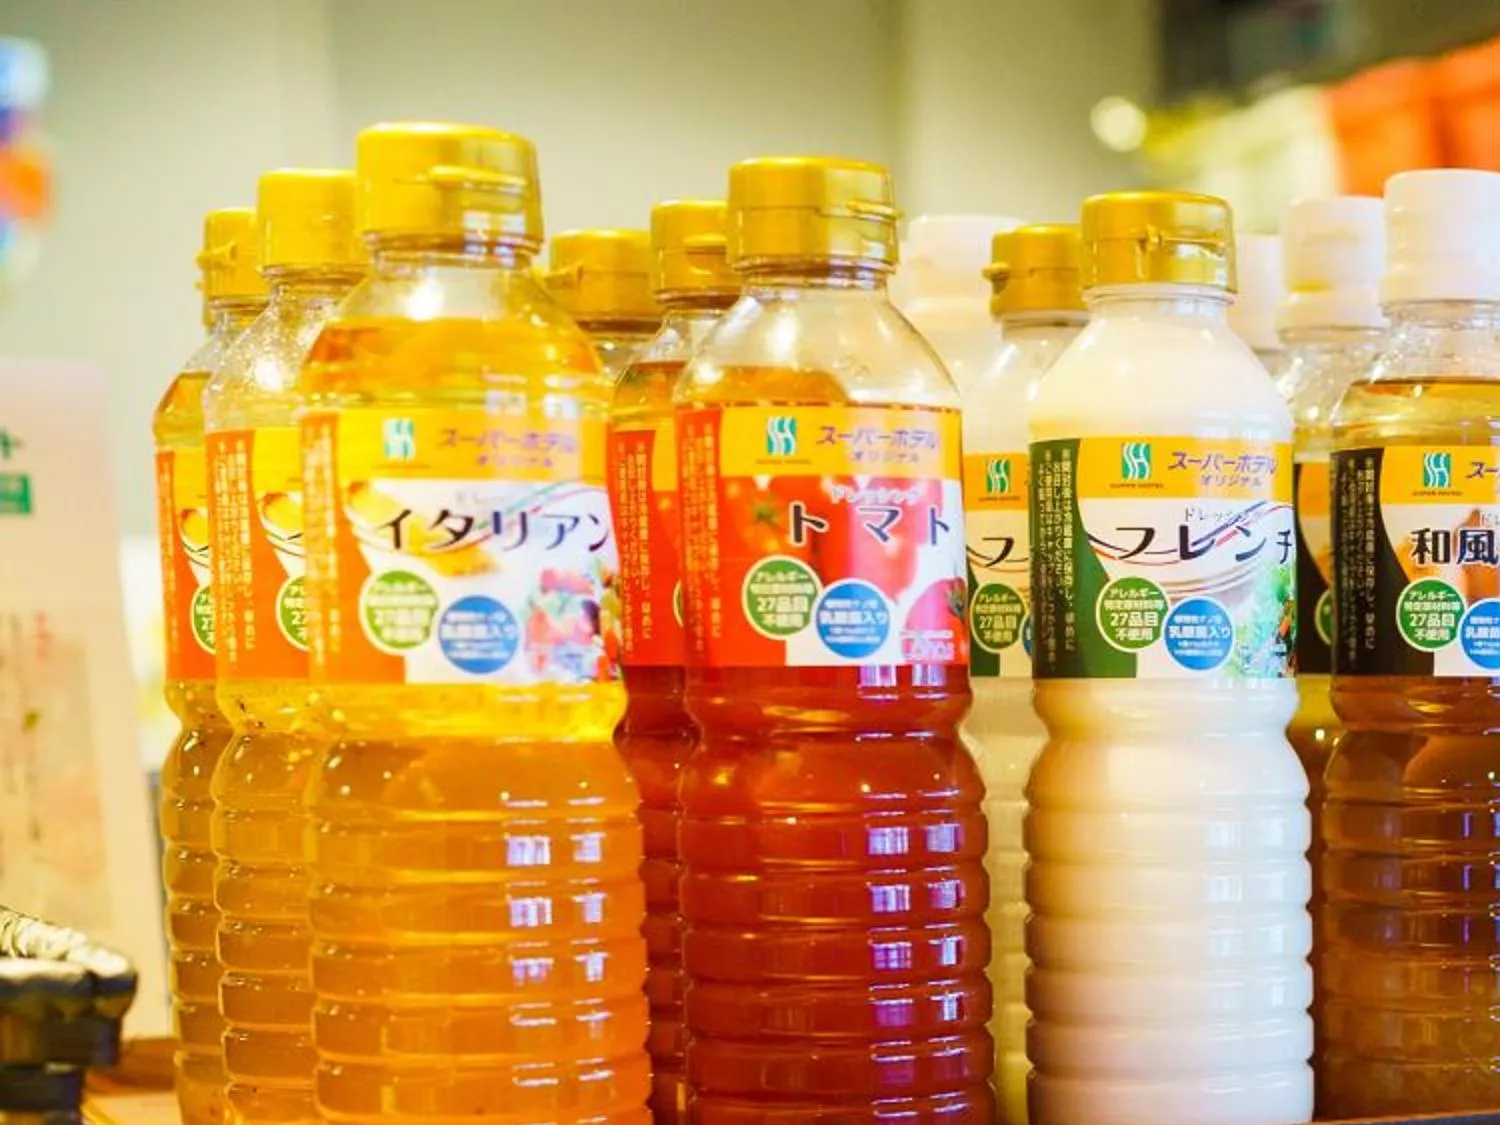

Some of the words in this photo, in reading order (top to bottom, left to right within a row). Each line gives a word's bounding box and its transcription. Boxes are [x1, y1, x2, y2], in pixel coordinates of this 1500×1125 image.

[1168, 450, 1278, 475] スーパーホテル
[379, 508, 609, 552] イタリアン
[792, 503, 951, 546] トマト
[1115, 524, 1293, 565] フレンチ
[1109, 588, 1160, 599] アレルギー
[1409, 591, 1457, 601] アレルギー
[1110, 611, 1159, 627] 27品目
[1409, 613, 1456, 628] 27品目
[1115, 627, 1153, 641] 不使用
[1415, 627, 1451, 641] 不使用
